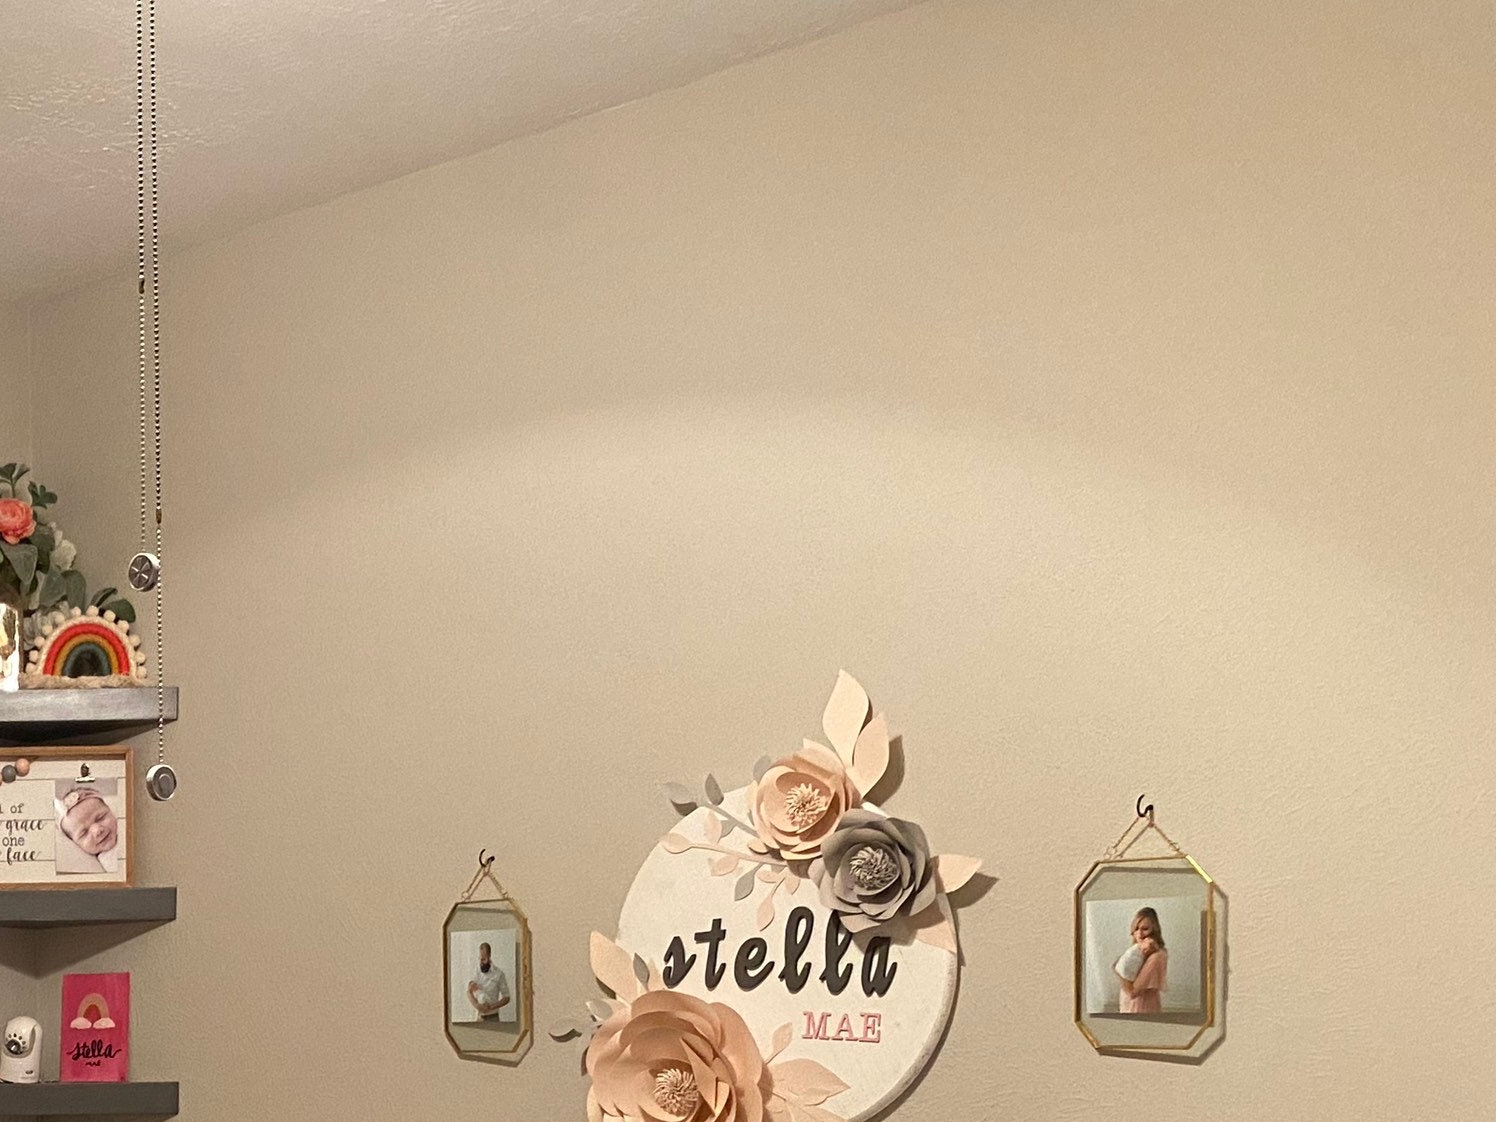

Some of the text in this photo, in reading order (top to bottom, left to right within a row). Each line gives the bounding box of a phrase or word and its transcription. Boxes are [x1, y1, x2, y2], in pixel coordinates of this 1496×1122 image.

[10, 803, 24, 814] of
[5, 819, 46, 837] grace
[2, 836, 25, 847] one
[6, 847, 41, 866] face
[662, 906, 898, 998] stella
[802, 1011, 882, 1043] MAE
